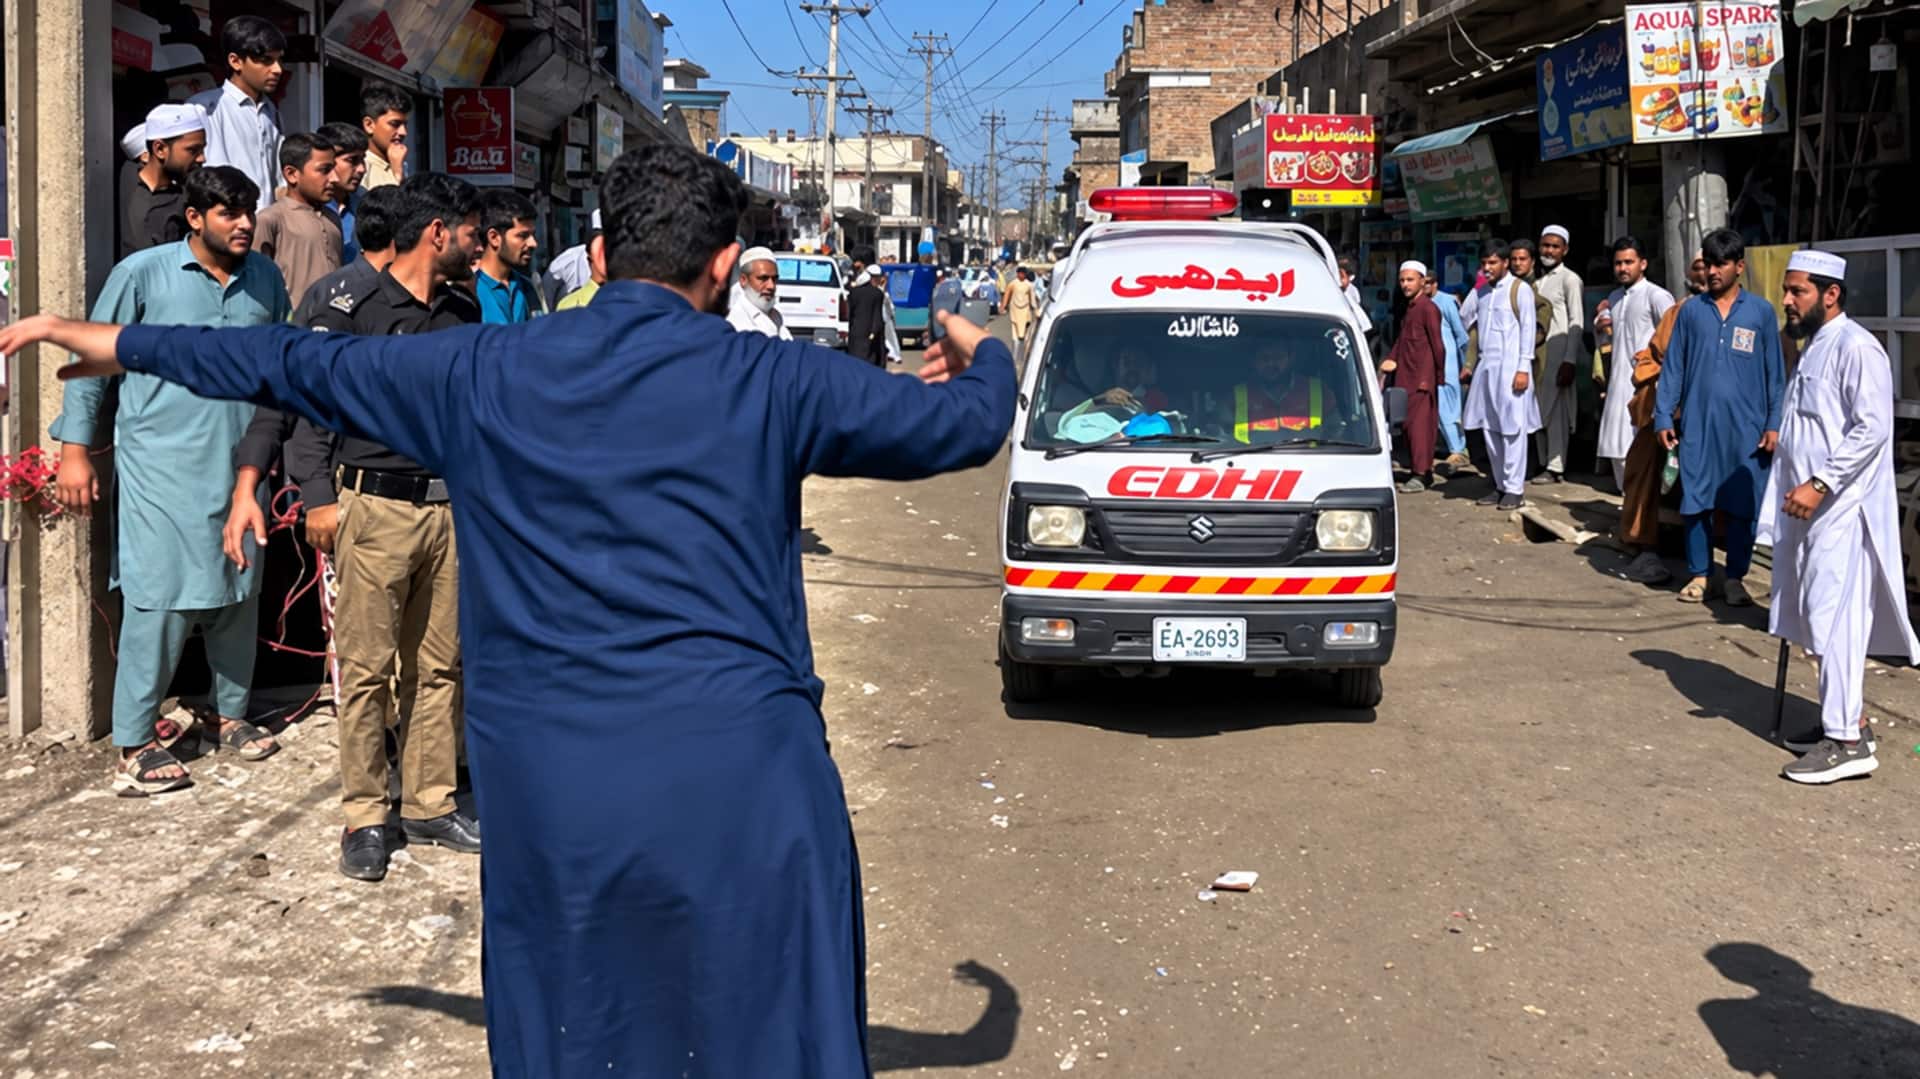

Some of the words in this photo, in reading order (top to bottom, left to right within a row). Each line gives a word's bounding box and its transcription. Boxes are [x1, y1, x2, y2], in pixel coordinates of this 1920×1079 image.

[1634, 10, 1694, 31] AQUA
[1706, 4, 1777, 27] SPARK
[1106, 465, 1304, 501] EDHI
[1160, 628, 1240, 649] EA-2693
